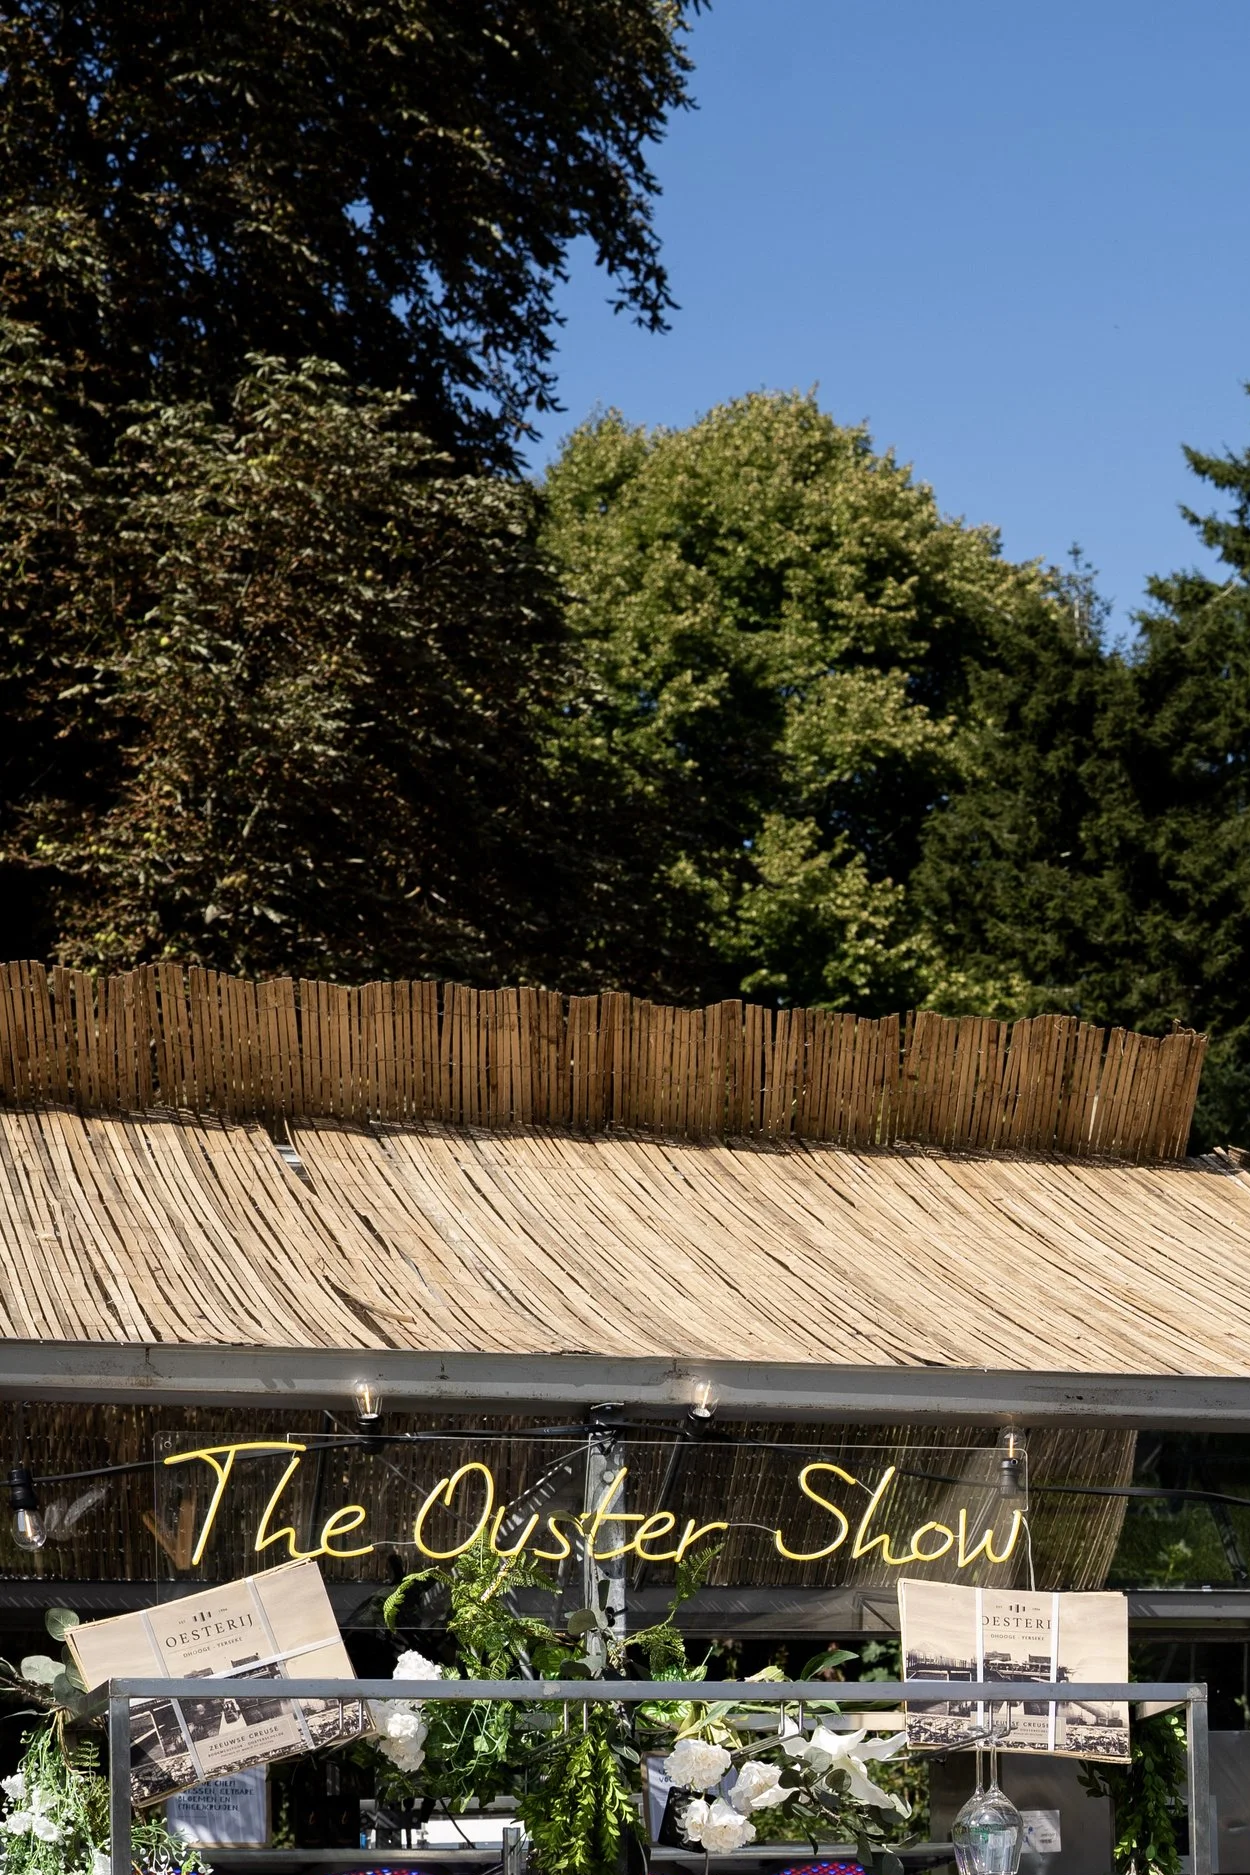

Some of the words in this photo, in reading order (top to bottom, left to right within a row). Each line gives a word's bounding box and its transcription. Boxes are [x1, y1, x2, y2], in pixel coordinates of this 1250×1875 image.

[164, 1441, 374, 1565] The
[775, 1463, 1021, 1568] Show
[165, 1613, 254, 1649] OESTERIJ
[208, 1736, 246, 1751] ZEEUWSE
[248, 1726, 279, 1739] CREUSE
